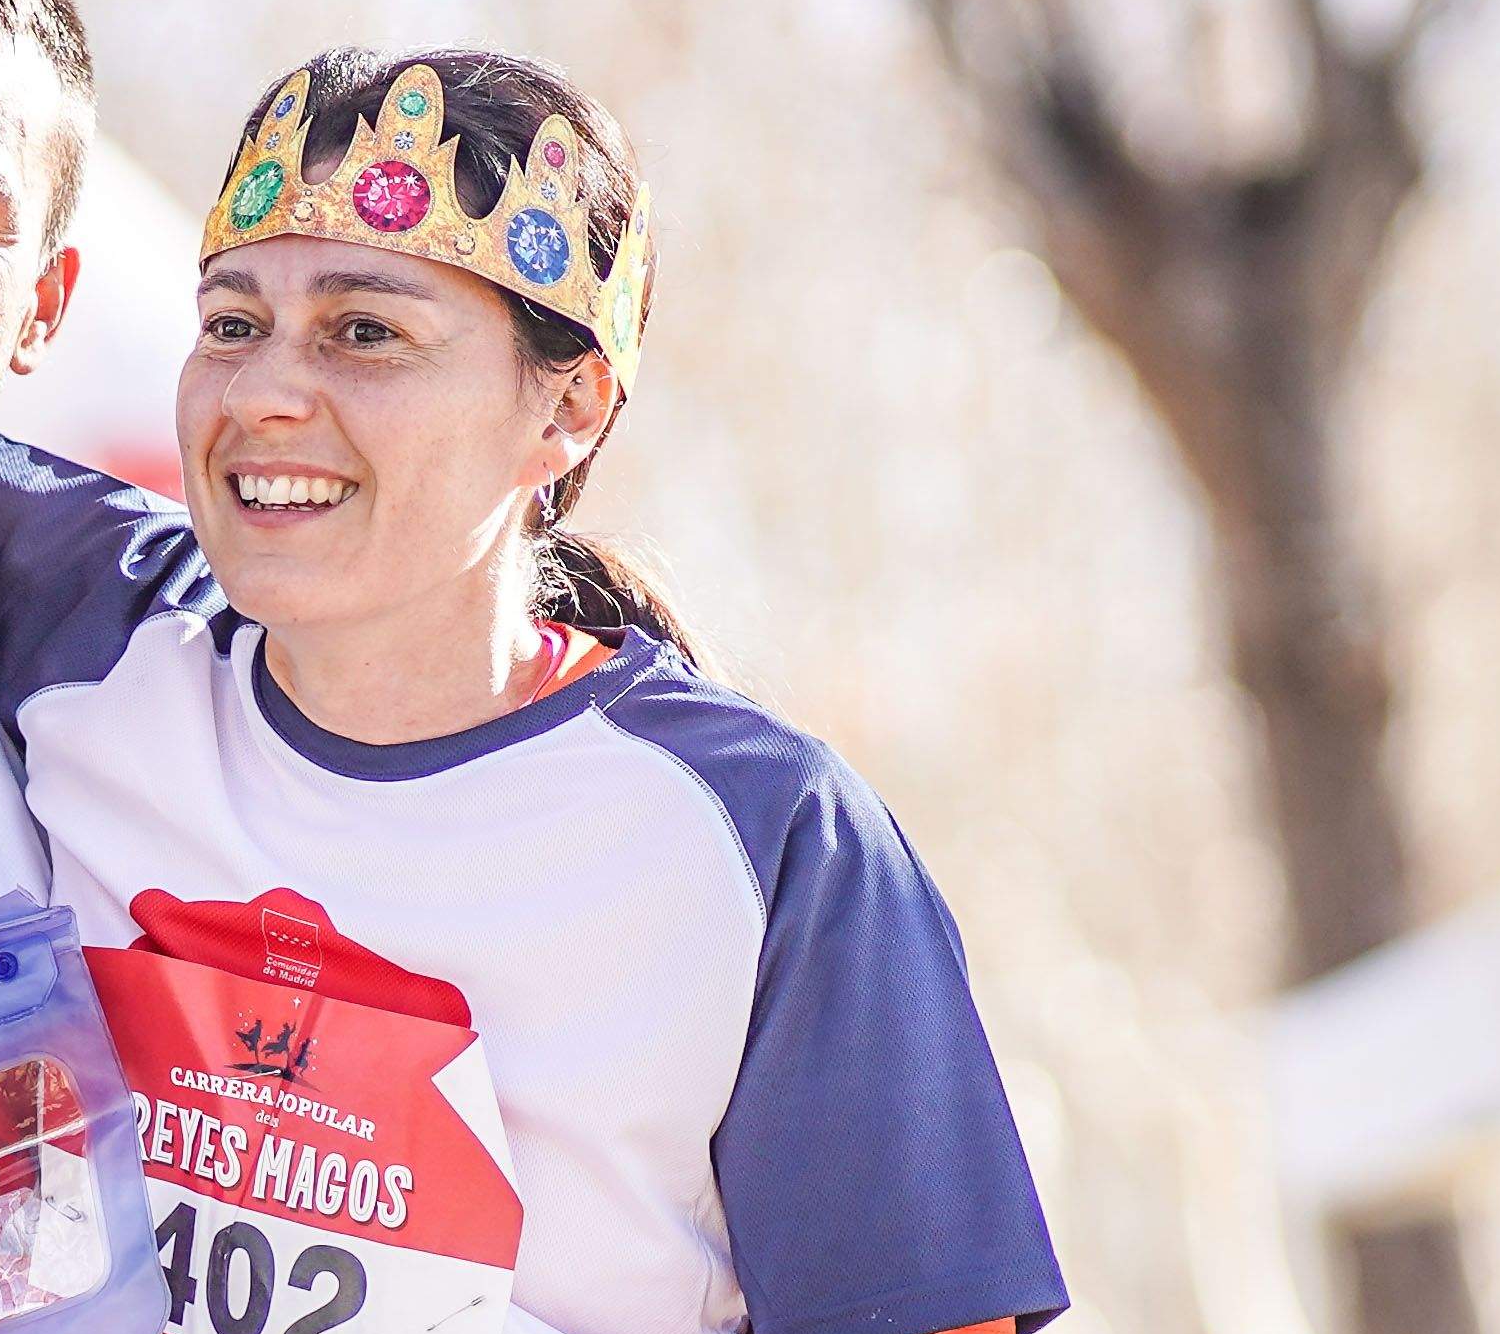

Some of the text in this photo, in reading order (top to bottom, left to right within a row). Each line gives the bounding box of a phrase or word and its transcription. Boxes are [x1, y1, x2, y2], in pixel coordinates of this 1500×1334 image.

[262, 966, 315, 987] de Madrid
[265, 956, 319, 979] Comunidad
[170, 1066, 275, 1107] CARRERA
[130, 1091, 415, 1230] REYES MAGOS
